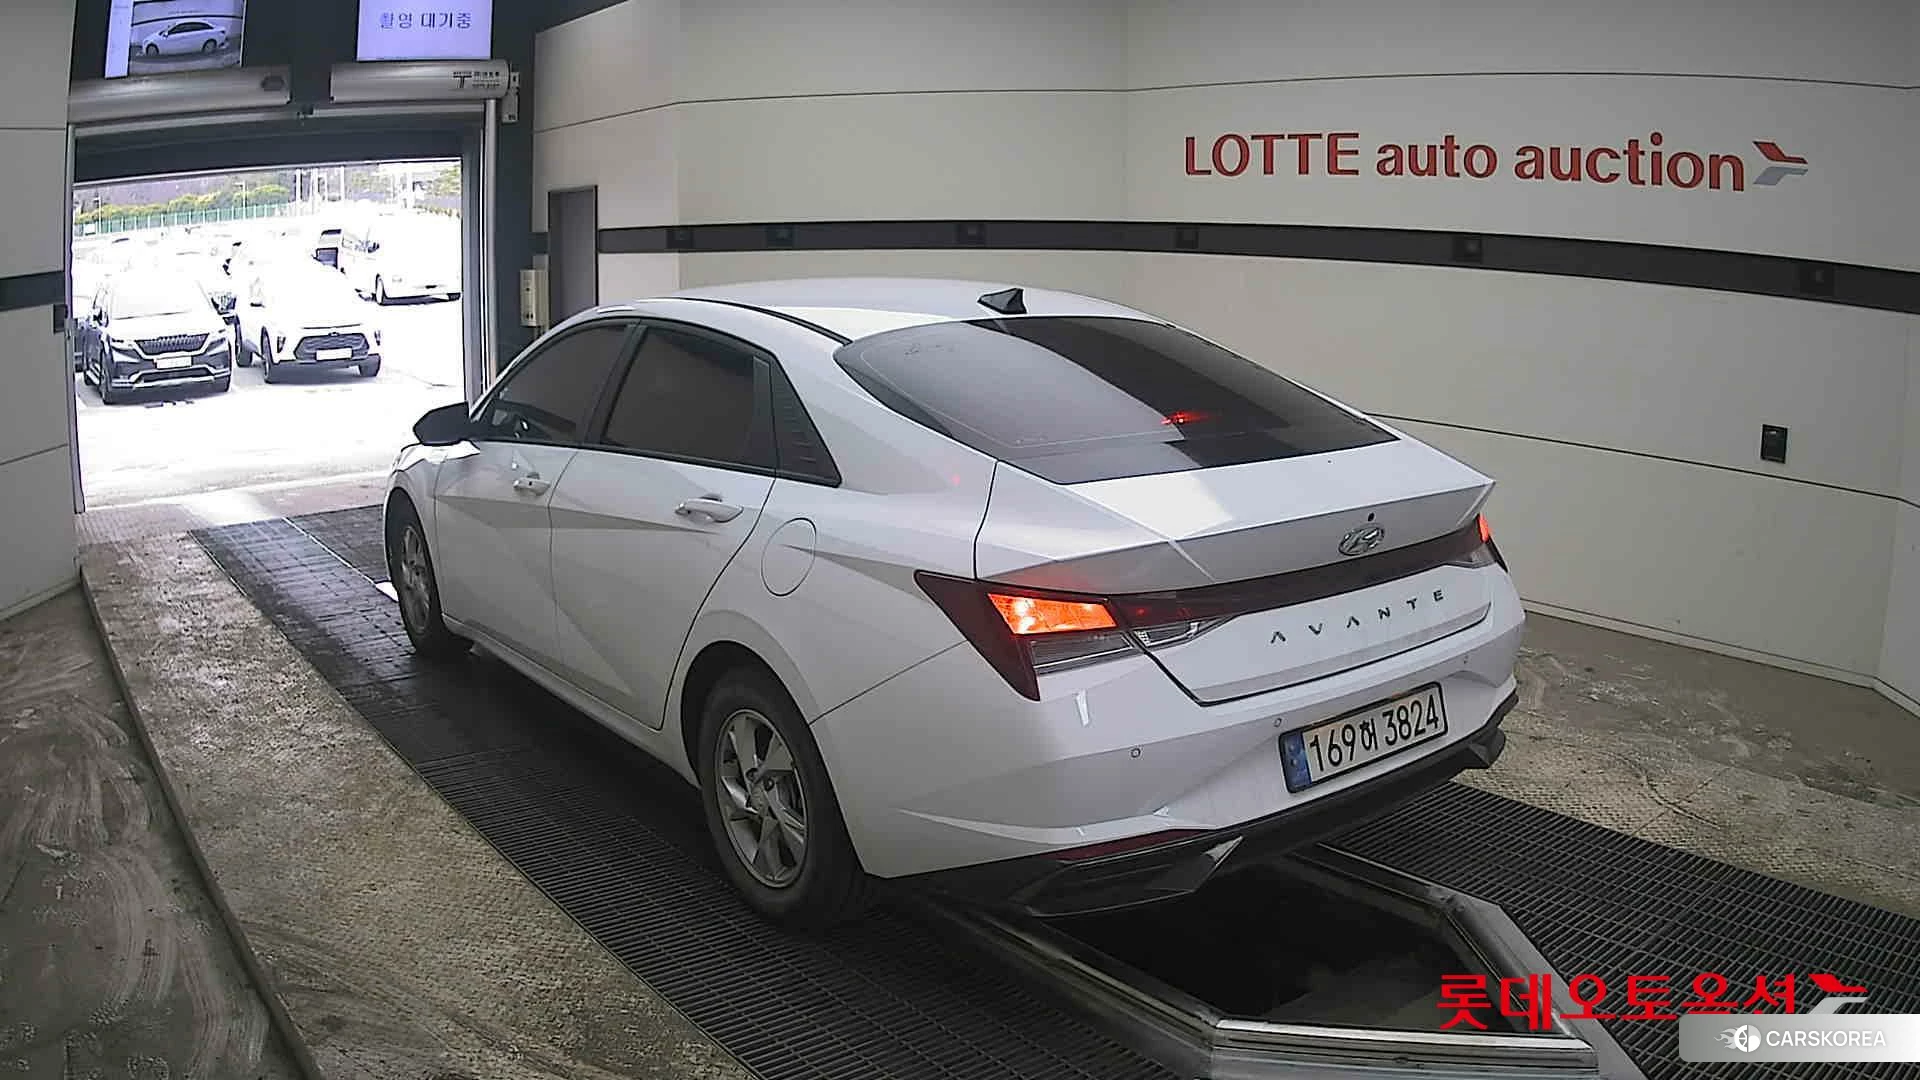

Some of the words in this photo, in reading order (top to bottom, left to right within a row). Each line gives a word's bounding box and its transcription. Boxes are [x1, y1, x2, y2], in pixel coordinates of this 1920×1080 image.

[421, 12, 471, 29] 대기중
[1184, 131, 1360, 177] LOTTE
[1375, 134, 1498, 179] auto
[1514, 131, 1745, 192] auction
[1270, 589, 1445, 645] AVANTE
[1309, 718, 1378, 772] 169허
[1382, 694, 1439, 746] 3824
